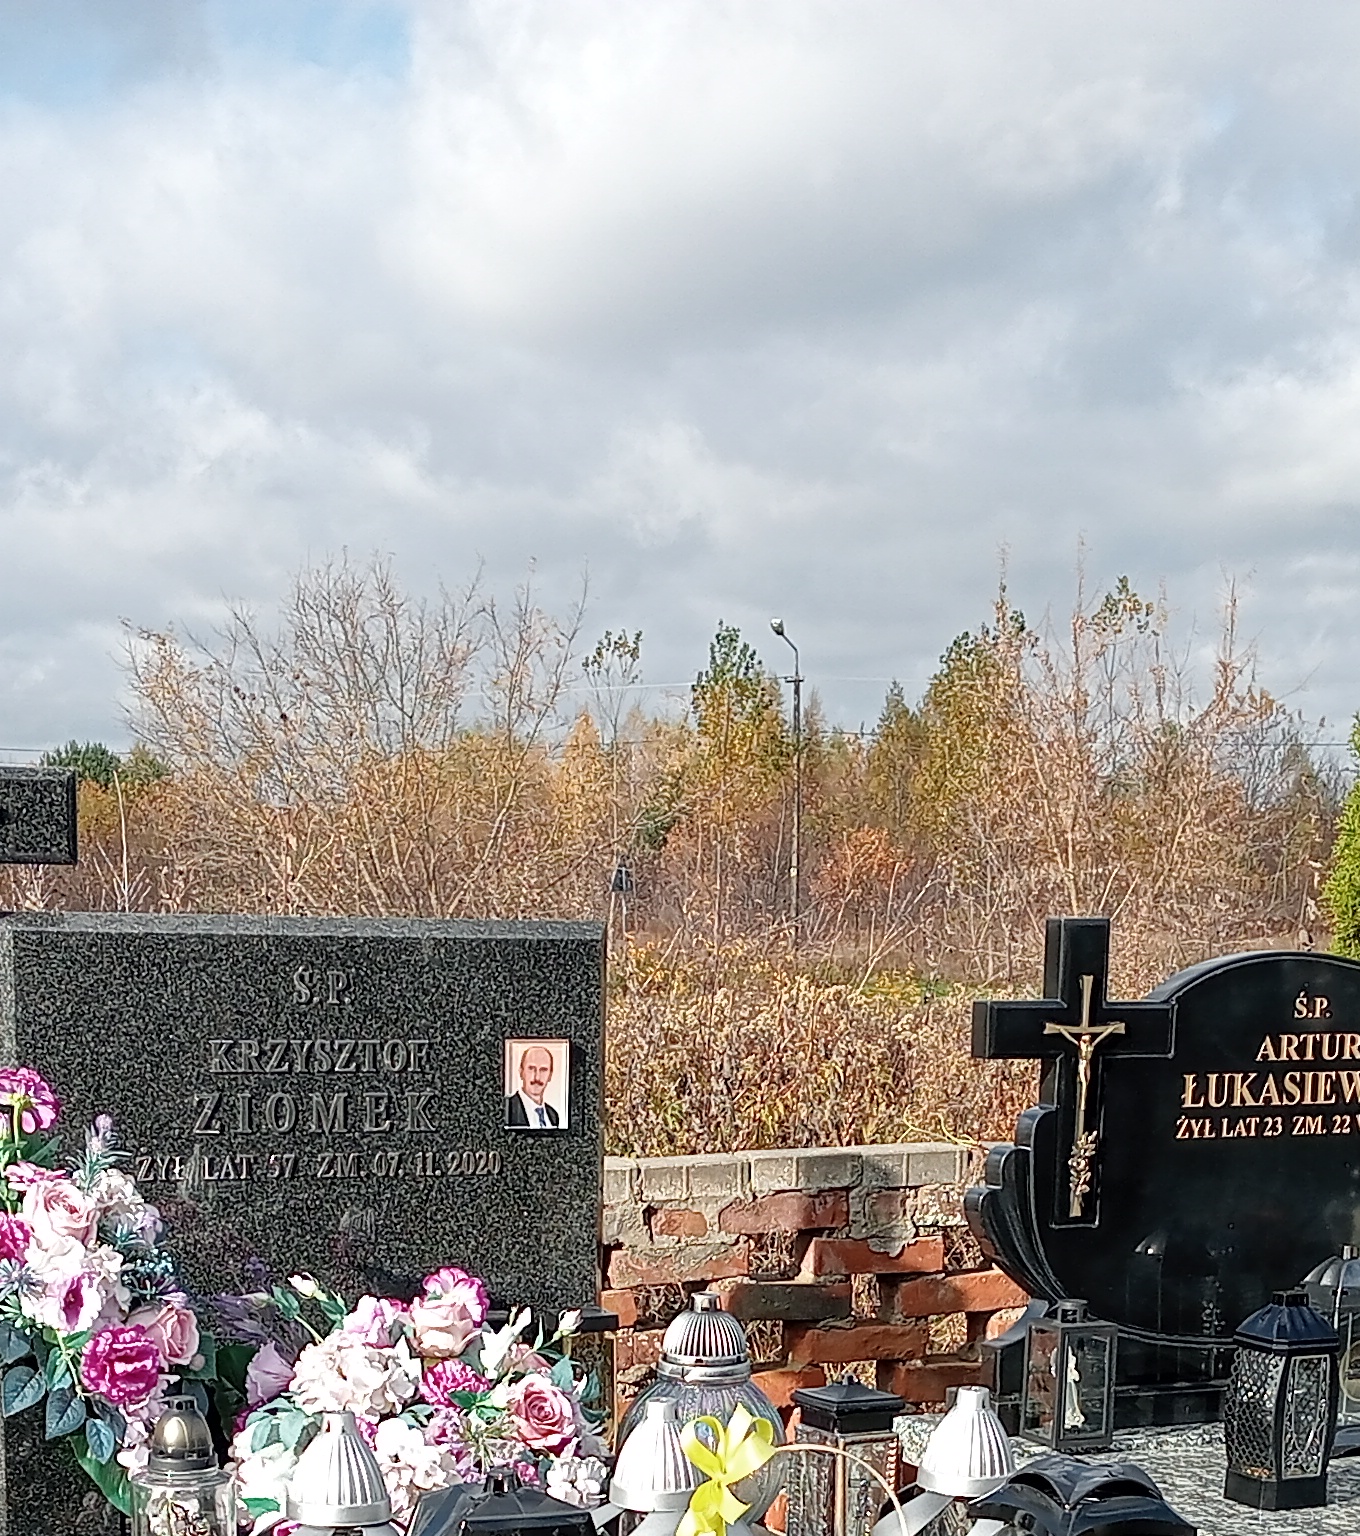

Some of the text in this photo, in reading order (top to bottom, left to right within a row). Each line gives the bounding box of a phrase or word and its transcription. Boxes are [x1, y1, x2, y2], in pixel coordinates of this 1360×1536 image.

[1293, 991, 1332, 1019] Ś.P.
[209, 1039, 430, 1073] KRZYSZTOF
[192, 1091, 438, 1135] ZIOMEK
[1175, 1115, 1216, 1139] ŻYŁ
[1221, 1117, 1260, 1138] LAT
[1263, 1116, 1283, 1136] 23
[1291, 1115, 1327, 1136] ZM.
[1332, 1114, 1351, 1134] 22
[202, 1153, 258, 1181] LAT
[266, 1153, 296, 1179] 57
[317, 1152, 367, 1178] ZM.
